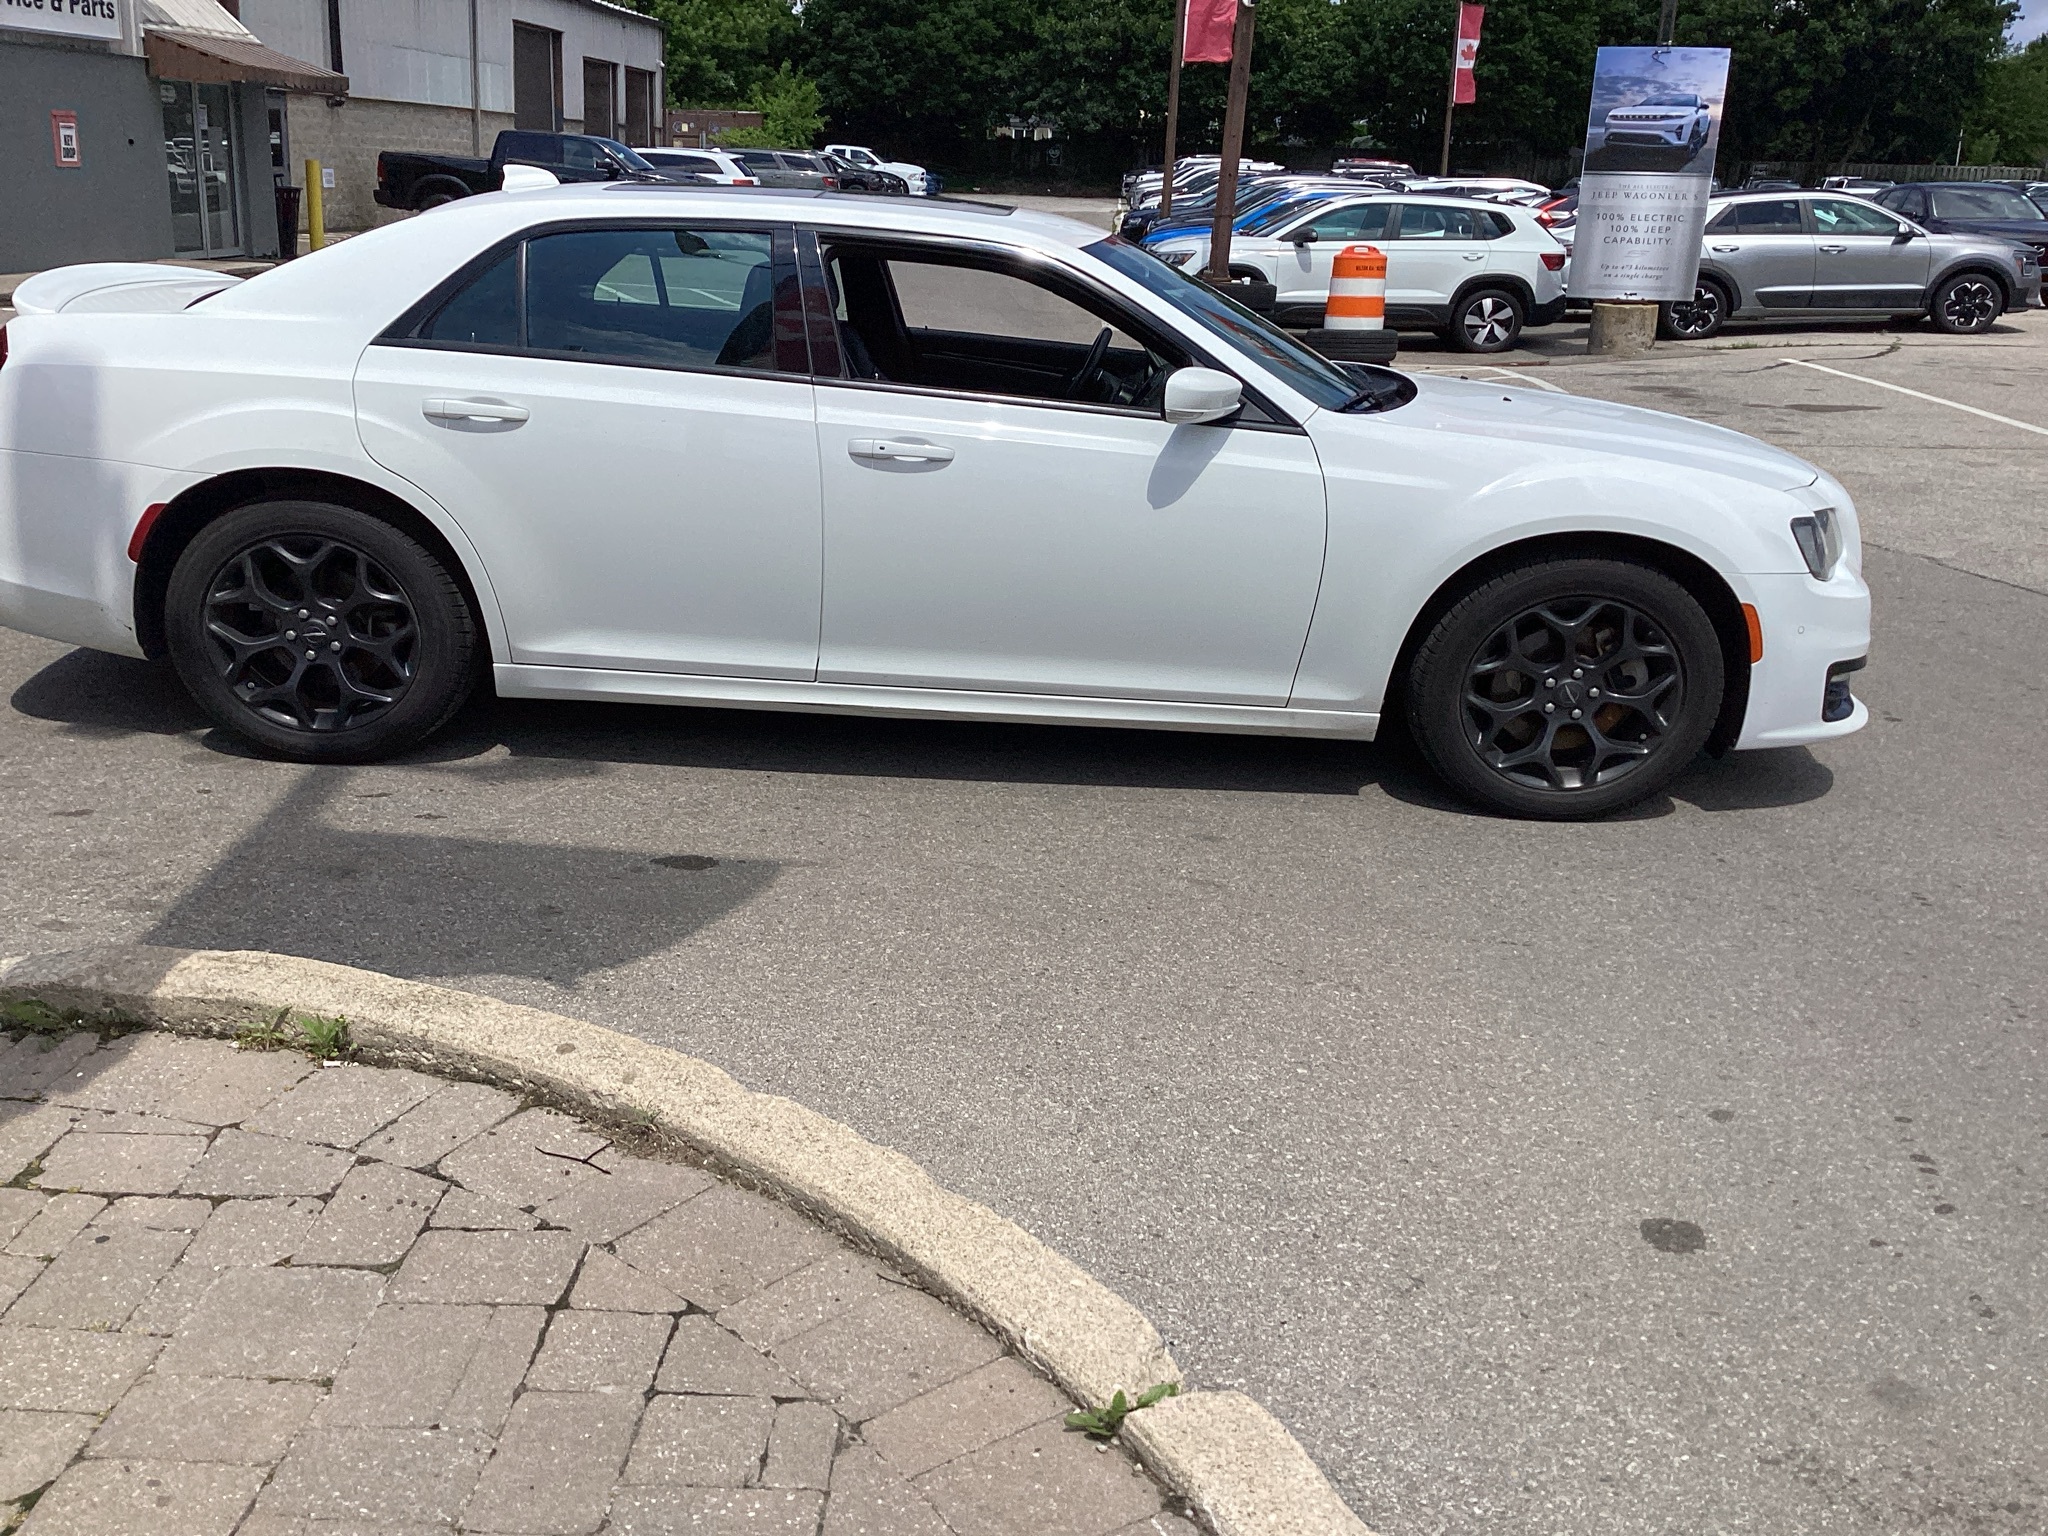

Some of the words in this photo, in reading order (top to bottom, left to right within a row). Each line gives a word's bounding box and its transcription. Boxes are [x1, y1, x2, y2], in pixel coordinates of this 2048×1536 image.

[69, 0, 115, 19] Parts
[1591, 191, 1618, 200] JEEP
[1596, 212, 1625, 221] 100%
[1610, 224, 1639, 233] 100%
[1643, 225, 1672, 234] JEEP
[1603, 236, 1673, 245] CAPABILITY.
[1600, 263, 1610, 271] Up
[1620, 272, 1639, 280] single
